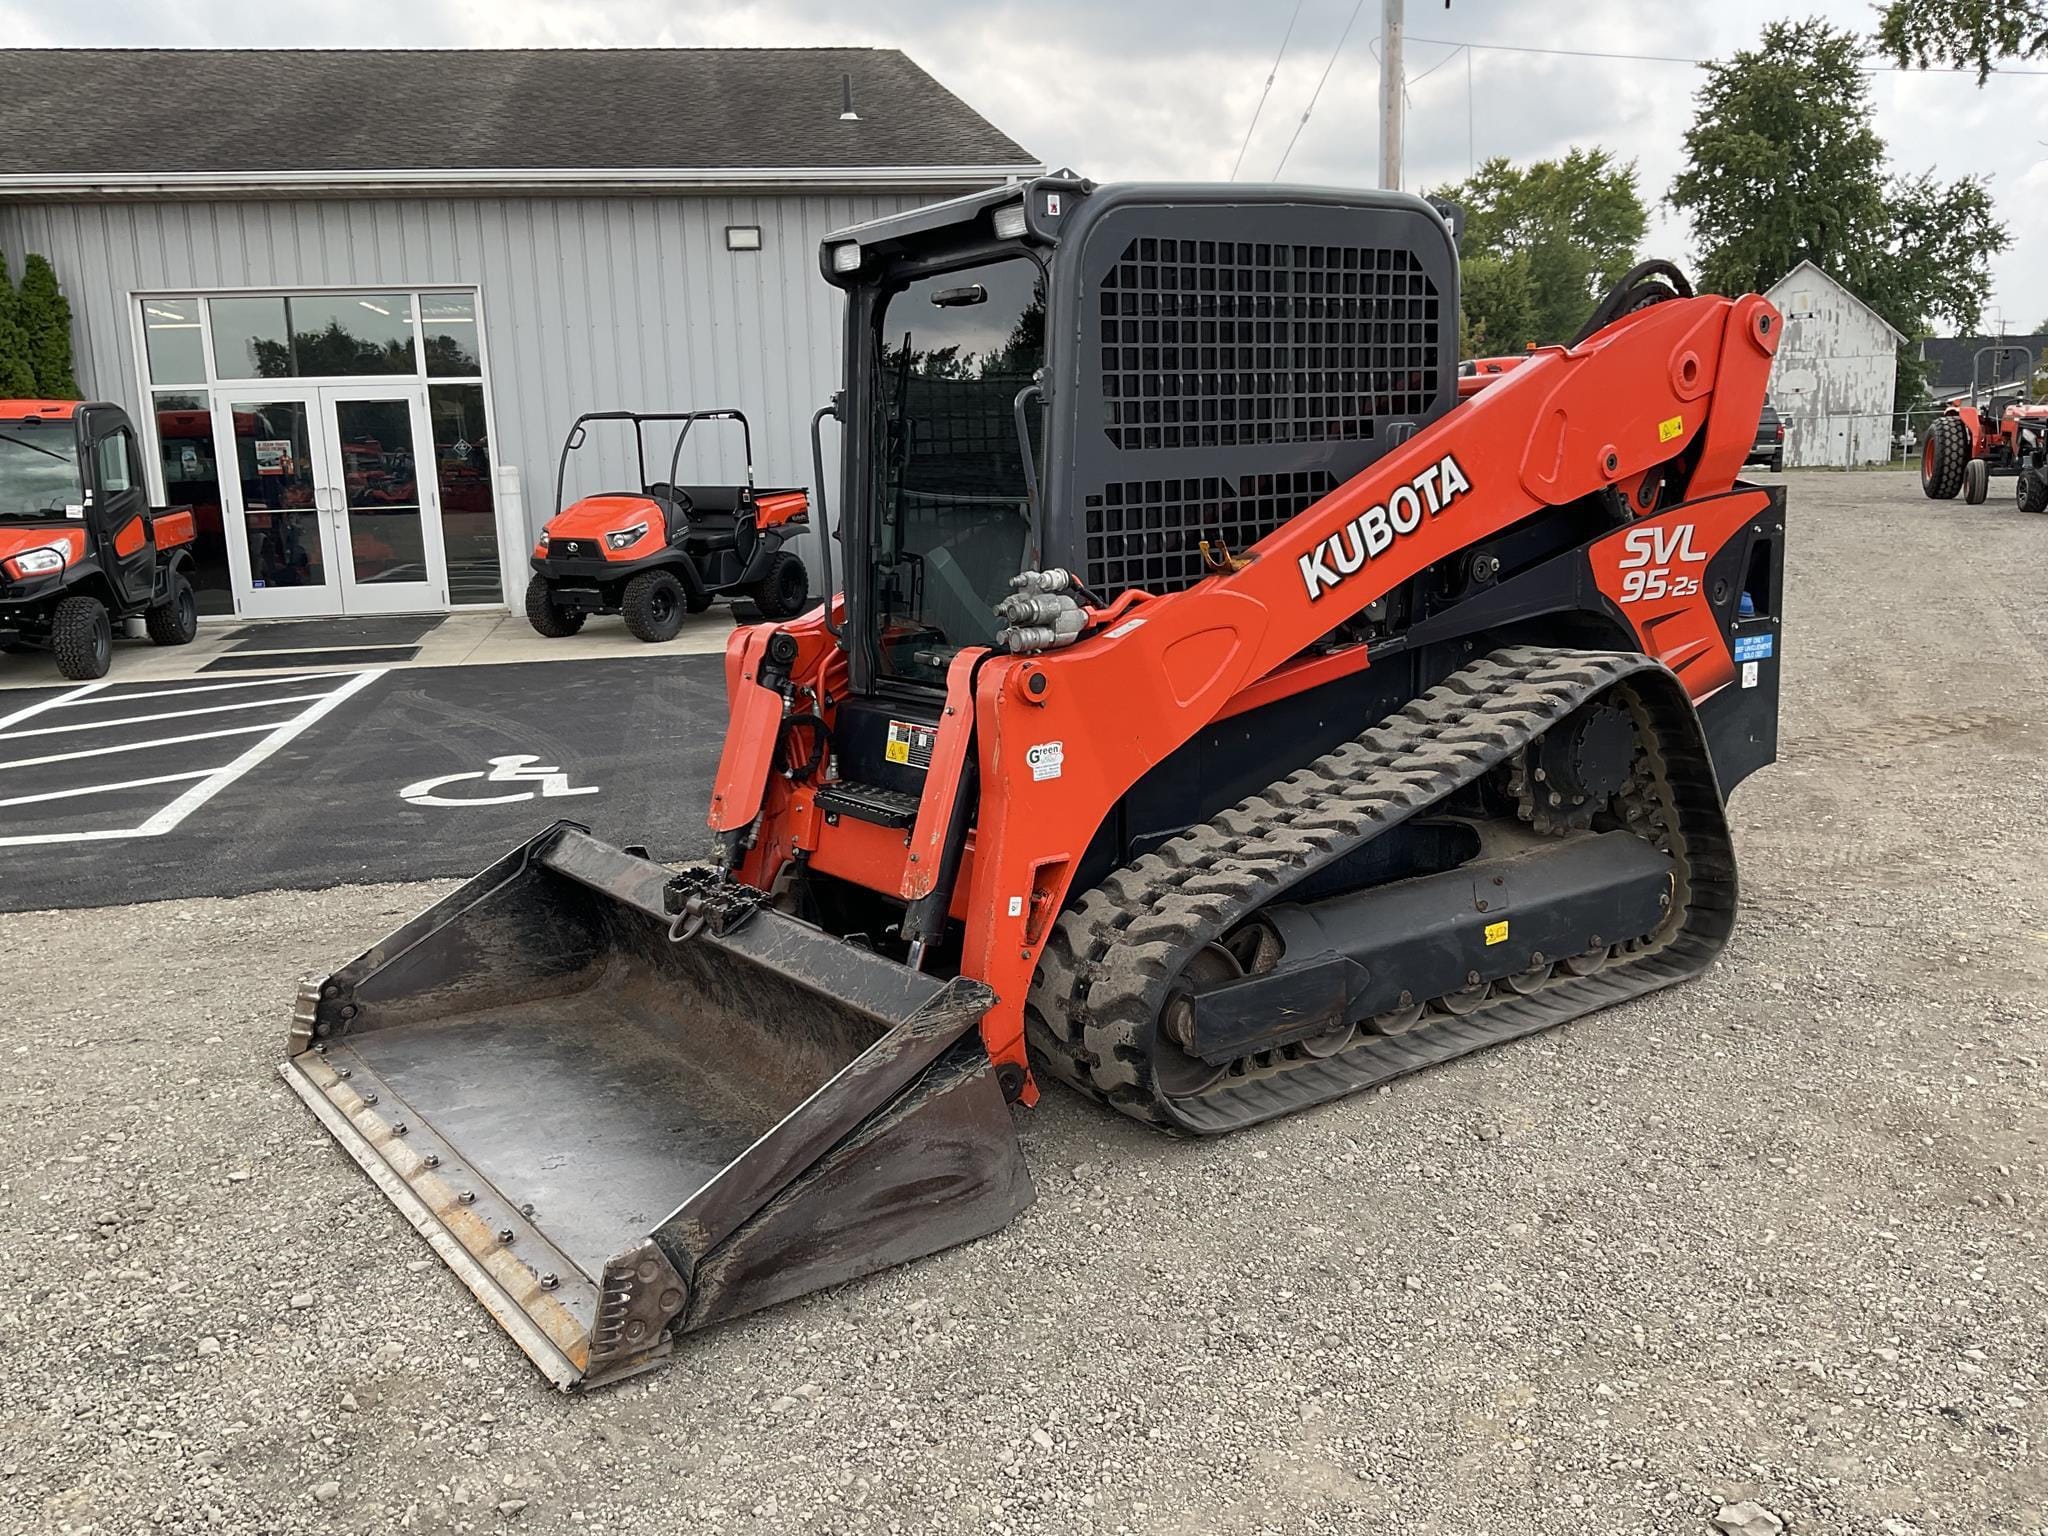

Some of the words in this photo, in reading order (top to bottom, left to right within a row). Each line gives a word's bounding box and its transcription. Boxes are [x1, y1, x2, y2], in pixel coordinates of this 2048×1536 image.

[1298, 455, 1470, 600] KUBOTA
[1619, 524, 1708, 569] SVL
[1029, 745, 1059, 764] Green
